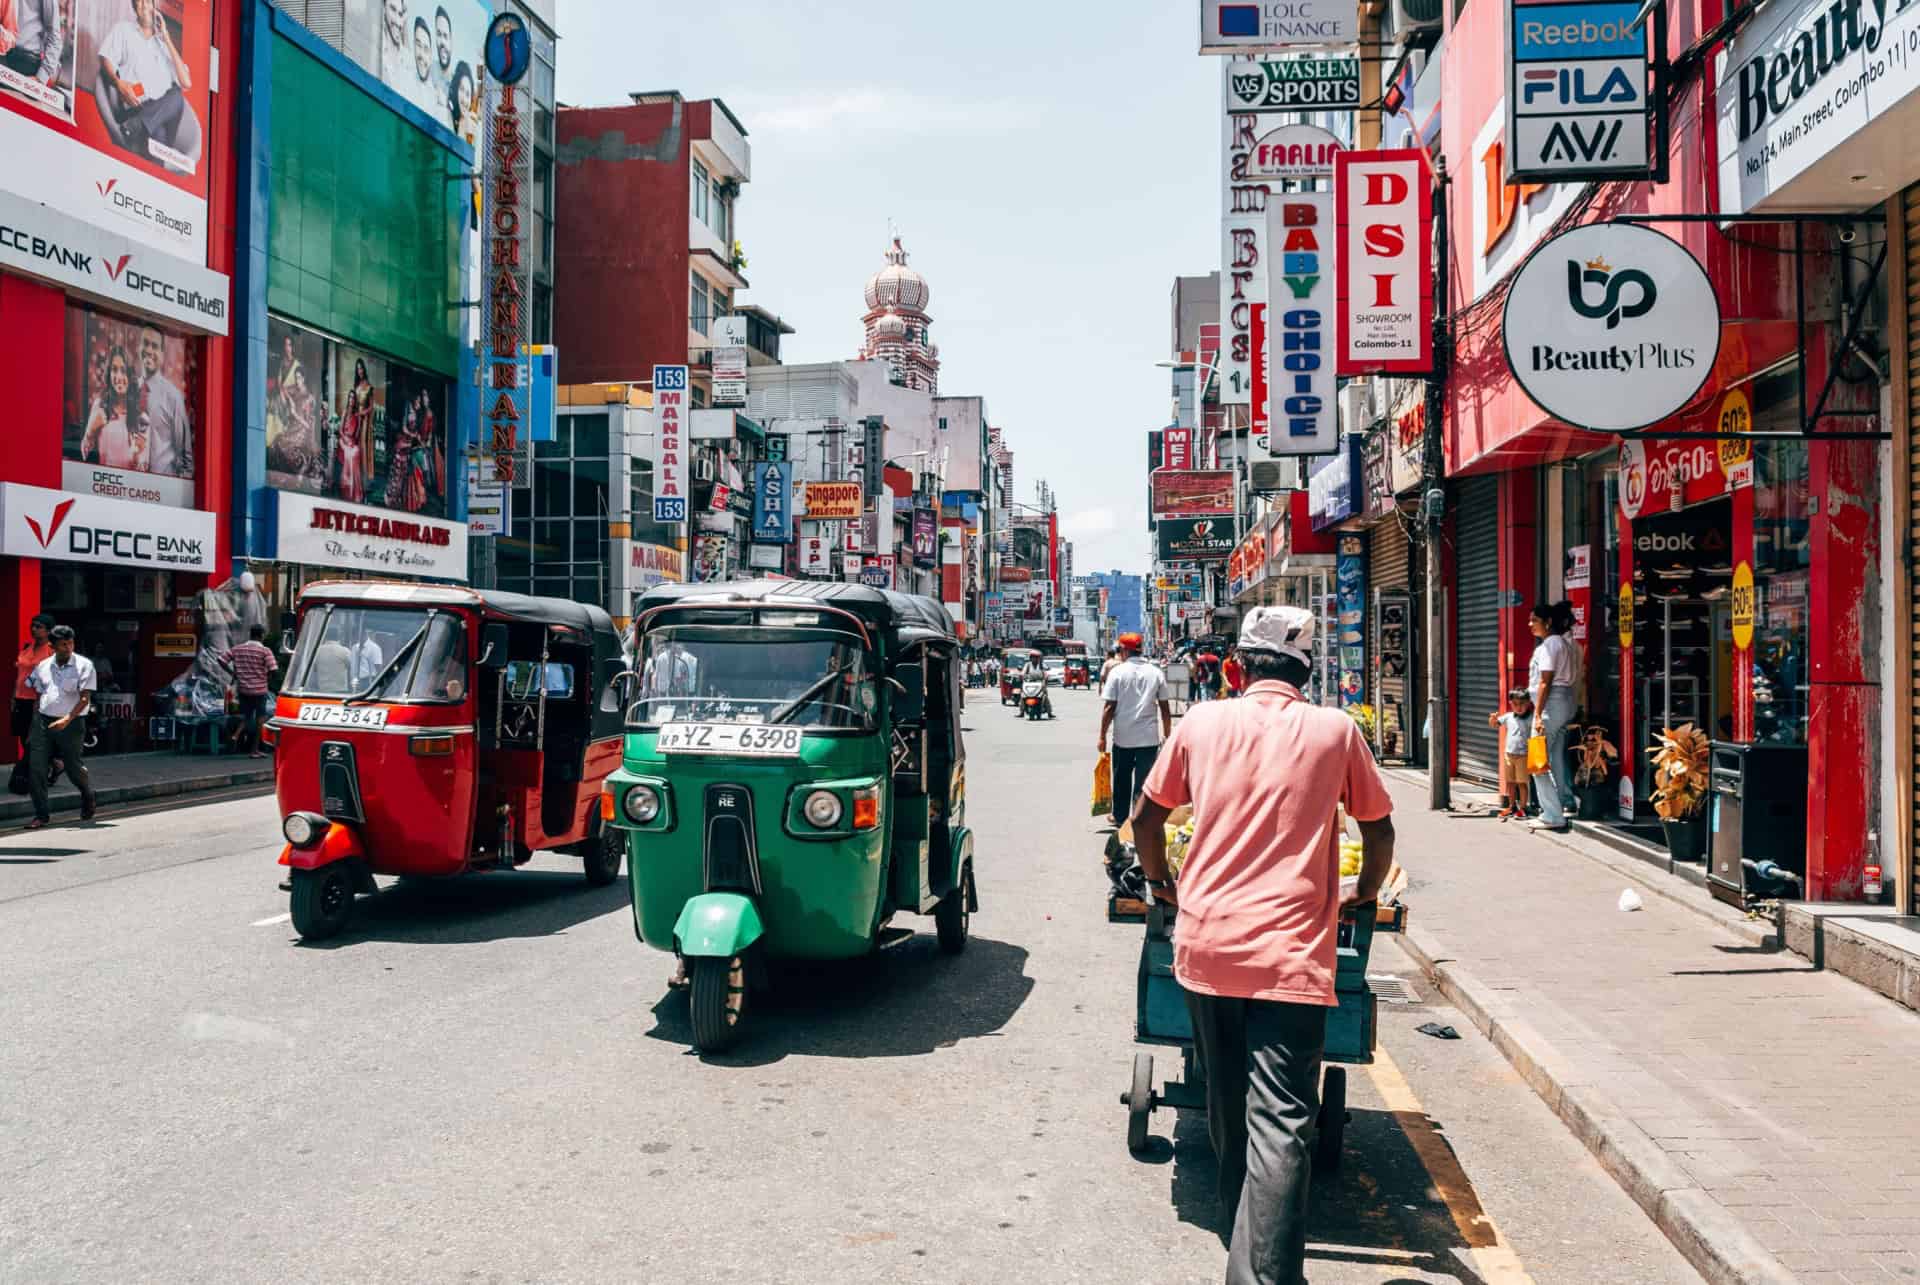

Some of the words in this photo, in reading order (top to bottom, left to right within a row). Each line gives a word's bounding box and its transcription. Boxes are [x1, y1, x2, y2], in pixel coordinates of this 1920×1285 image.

[1264, 3, 1312, 18] LOLC
[1264, 21, 1342, 36] FINANCE
[1523, 19, 1636, 44] Reebok
[1270, 60, 1357, 80] WASEEM
[1269, 80, 1358, 103] SPORTS
[1524, 66, 1638, 104] FILA
[1834, 59, 1885, 109] Colombo
[113, 190, 153, 219] DFCC
[1282, 203, 1321, 299] BABY
[1362, 173, 1409, 308] DSI
[32, 239, 93, 274] BANK
[126, 269, 176, 303] DFCC
[1356, 313, 1412, 324] SHOWROOM
[1354, 339, 1412, 348] Colombo-11
[655, 370, 685, 388] 153
[1283, 309, 1323, 437] CHOICE
[660, 392, 681, 496] MANGALA
[93, 471, 123, 485] DFCC
[92, 483, 128, 497] CREDIT
[129, 488, 161, 502] CARDS
[764, 465, 782, 528] ASHA
[806, 485, 859, 506] Singapore
[655, 500, 685, 519] 153
[310, 507, 450, 546] JEYECHANDRANS
[69, 526, 151, 560] DFCC
[157, 535, 202, 554] BANK
[1207, 539, 1232, 547] STAR
